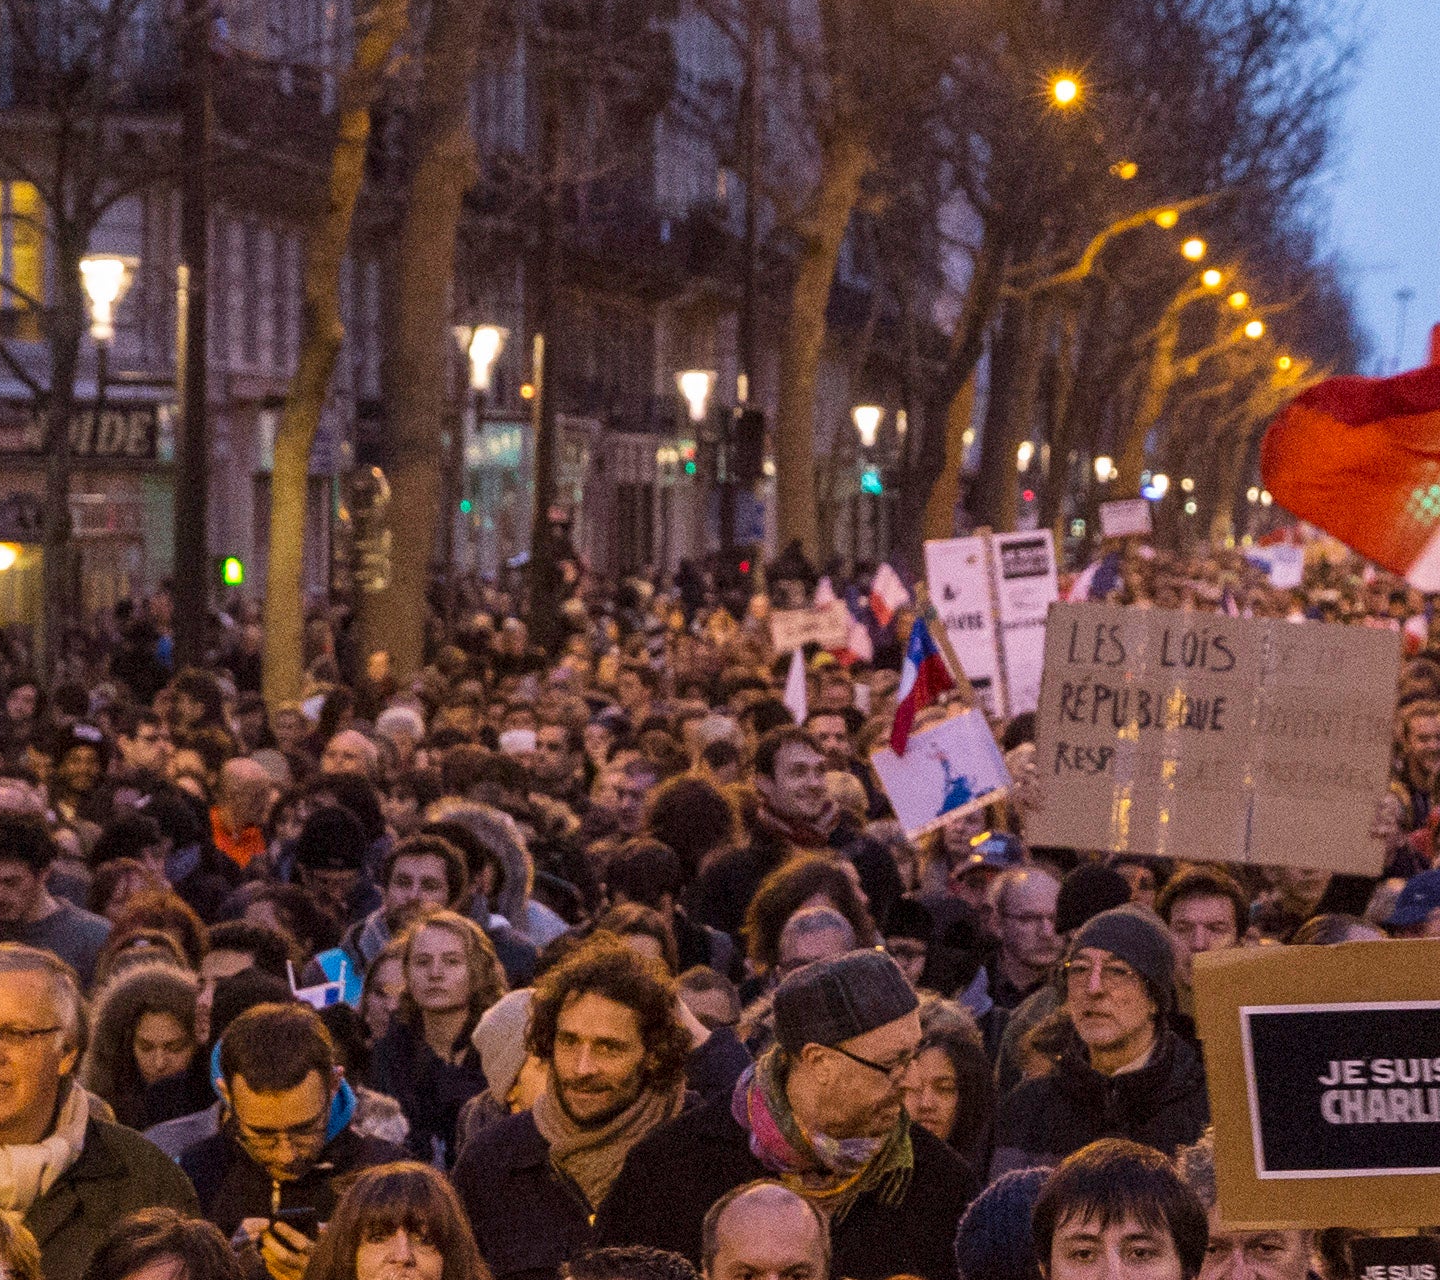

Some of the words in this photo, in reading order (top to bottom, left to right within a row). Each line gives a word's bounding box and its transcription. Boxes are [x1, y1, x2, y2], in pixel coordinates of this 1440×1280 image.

[1068, 623, 1126, 666] LES
[1317, 1060, 1368, 1086] JE
[1388, 1264, 1438, 1280] SUIS
